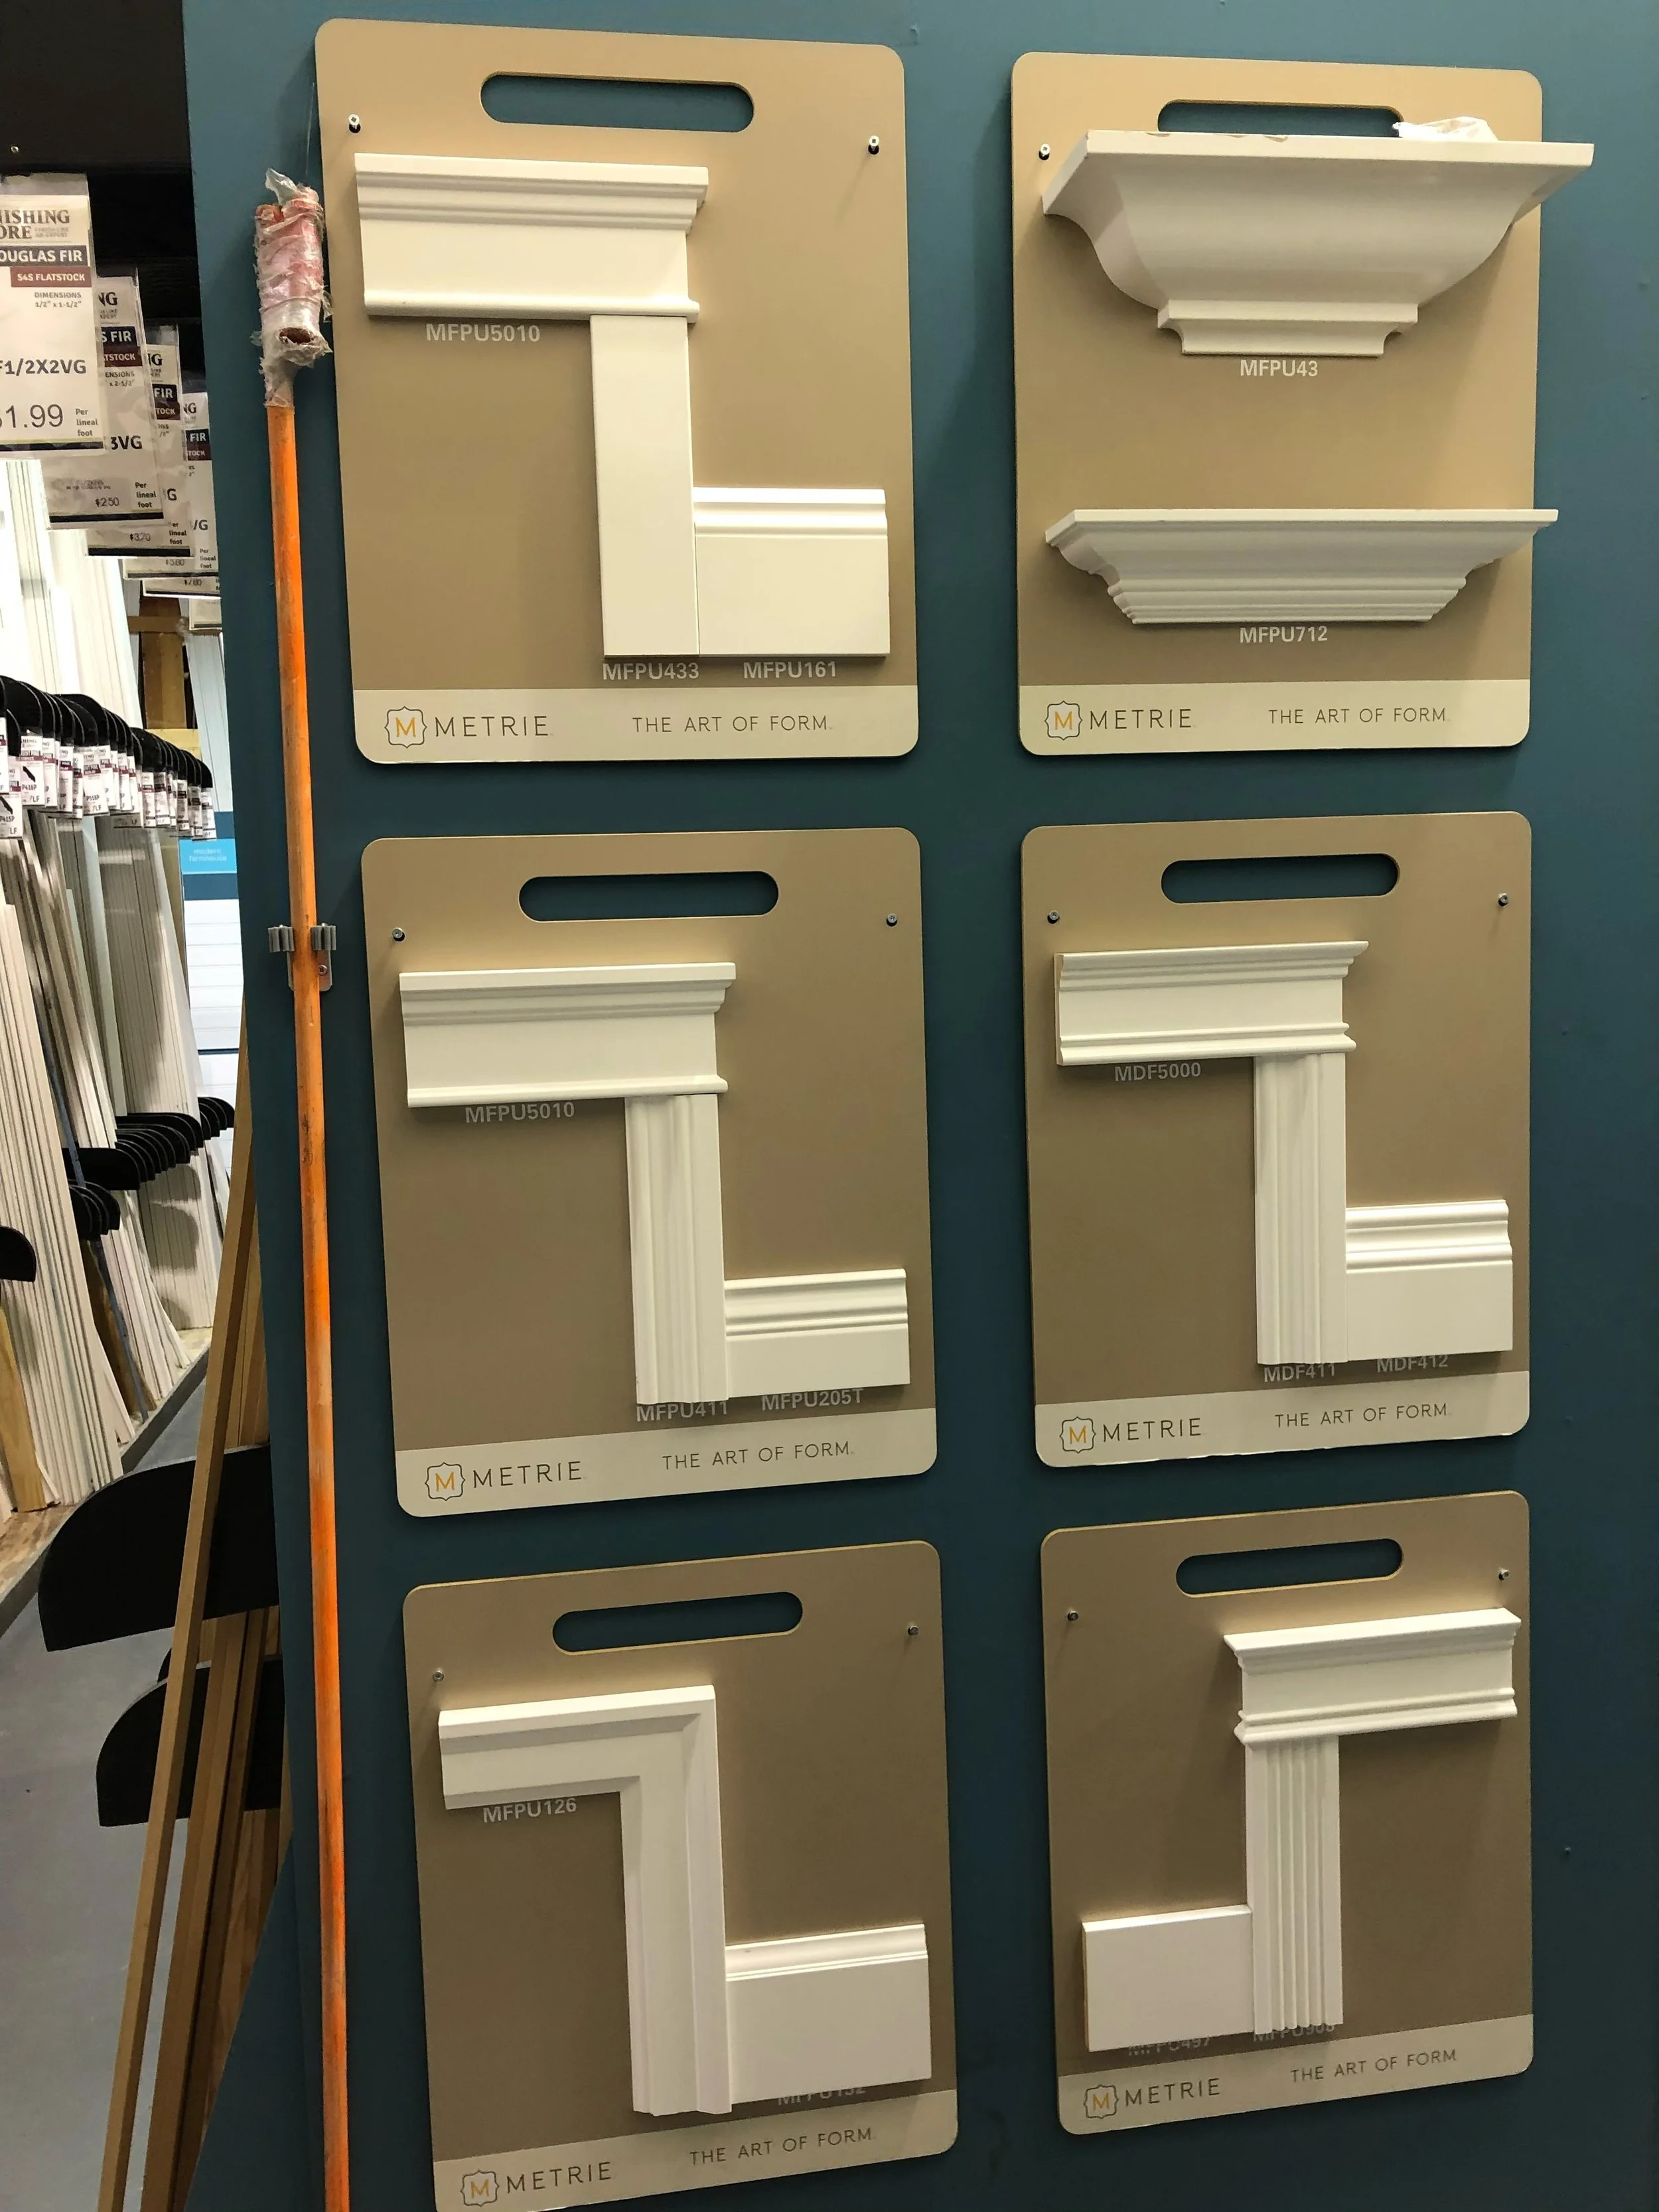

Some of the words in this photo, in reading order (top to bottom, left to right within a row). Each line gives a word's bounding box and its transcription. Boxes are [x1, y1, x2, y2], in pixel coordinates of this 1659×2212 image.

[60, 250, 82, 262] FIR
[36, 273, 85, 281] FLATSTOCK
[110, 331, 131, 342] FIR
[425, 323, 541, 342] MFPU5010
[1240, 359, 1318, 377] MFPU43
[154, 388, 173, 398] FIR
[0, 404, 63, 428] 1.99
[111, 435, 143, 450] 3VG
[190, 432, 206, 442] FIR
[1240, 625, 1328, 644] MFPU712
[602, 662, 699, 680] MFPU433
[743, 660, 836, 679] MFPU161
[632, 717, 672, 733] THE
[684, 716, 722, 732] ART
[732, 715, 759, 732] OF
[1090, 709, 1192, 730] METRIE
[1268, 709, 1304, 724] THE
[1315, 709, 1350, 724] ART
[1359, 707, 1384, 723] OF
[435, 715, 549, 737] METRIE
[1114, 1062, 1201, 1082] MDF5000
[465, 1102, 575, 1124] MFPU5010
[1263, 1363, 1335, 1383] MDF411
[1376, 1355, 1449, 1373] MDF412
[762, 1388, 864, 1412] MFPU205T
[636, 1400, 728, 1422] MFPU411
[1275, 1412, 1310, 1428] THE
[1321, 1409, 1354, 1425] ART
[1362, 1406, 1387, 1422] OF
[1103, 1418, 1202, 1442] METRIE
[662, 1453, 701, 1470] THE
[711, 1449, 749, 1466] ART
[758, 1445, 784, 1462] OF
[472, 1461, 582, 1489] METRIE
[482, 1797, 577, 1823] MFPU126
[1291, 2066, 1325, 2083] THE
[1334, 2060, 1366, 2078] ART
[1375, 2056, 1398, 2072] OF
[1406, 2049, 1457, 2067] FORM
[1125, 2078, 1220, 2106] METRIE
[689, 2147, 727, 2166] THE
[738, 2140, 773, 2159] ART
[782, 2136, 808, 2152] OF
[506, 2161, 611, 2193] METRIE
